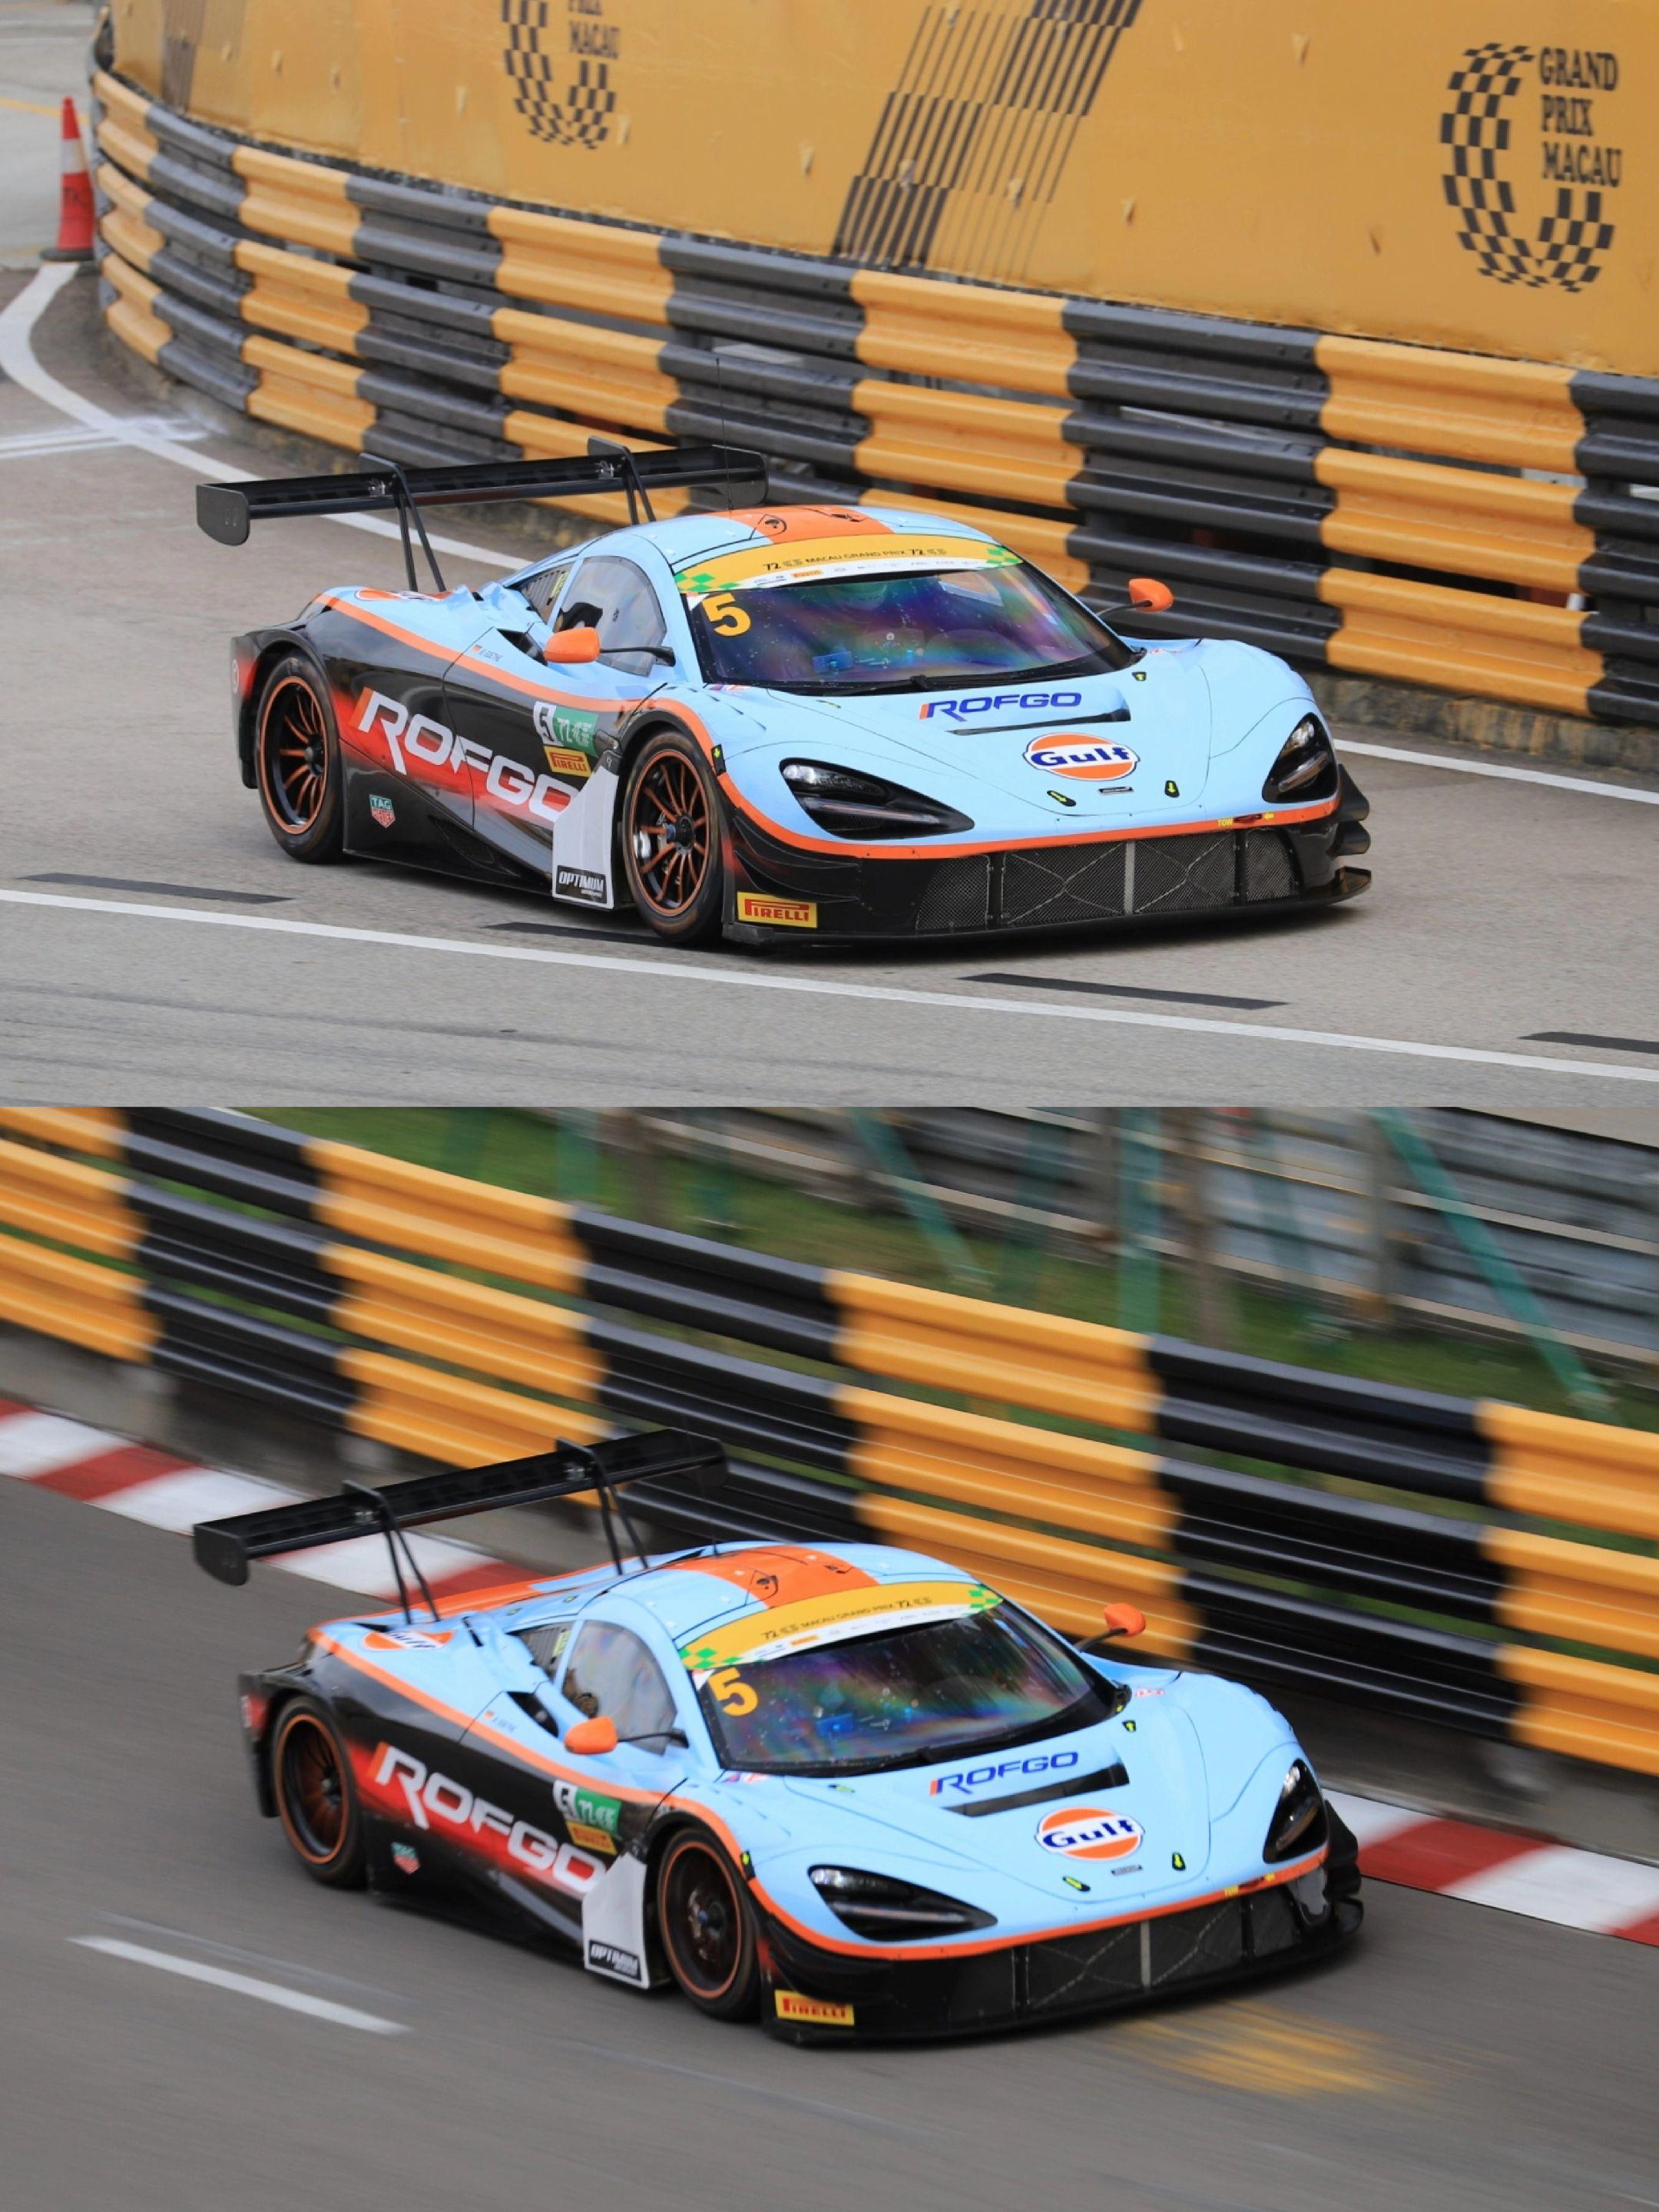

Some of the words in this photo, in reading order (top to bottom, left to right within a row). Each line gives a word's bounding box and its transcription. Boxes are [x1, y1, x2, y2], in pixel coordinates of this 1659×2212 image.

[1539, 46, 1618, 91] GRAND
[1541, 94, 1593, 137] PRIX
[1542, 141, 1621, 188] MACAU
[763, 562, 780, 571] 72
[805, 555, 842, 563] MACAU
[843, 551, 881, 560] GRAND
[702, 593, 751, 637] 5
[919, 692, 1081, 722] ROFGO
[538, 707, 555, 743] 5
[556, 717, 573, 743] 72
[349, 686, 581, 823] ROFGO
[548, 752, 588, 772] PIRELLI
[1030, 745, 1131, 767] Gulf
[372, 797, 392, 810] TAG
[1217, 817, 1233, 828] TOW
[558, 871, 604, 892] OPTIMUM
[743, 899, 810, 922] PIRELLI
[801, 1615, 835, 1628] MACAU
[836, 1608, 871, 1620] GRAND
[708, 1667, 758, 1717] 5
[929, 1751, 1078, 1796] ROFGO
[368, 1741, 608, 1895] ROFGO
[1043, 1820, 1134, 1848] Gulf
[783, 1997, 846, 2018] PIRELLI
